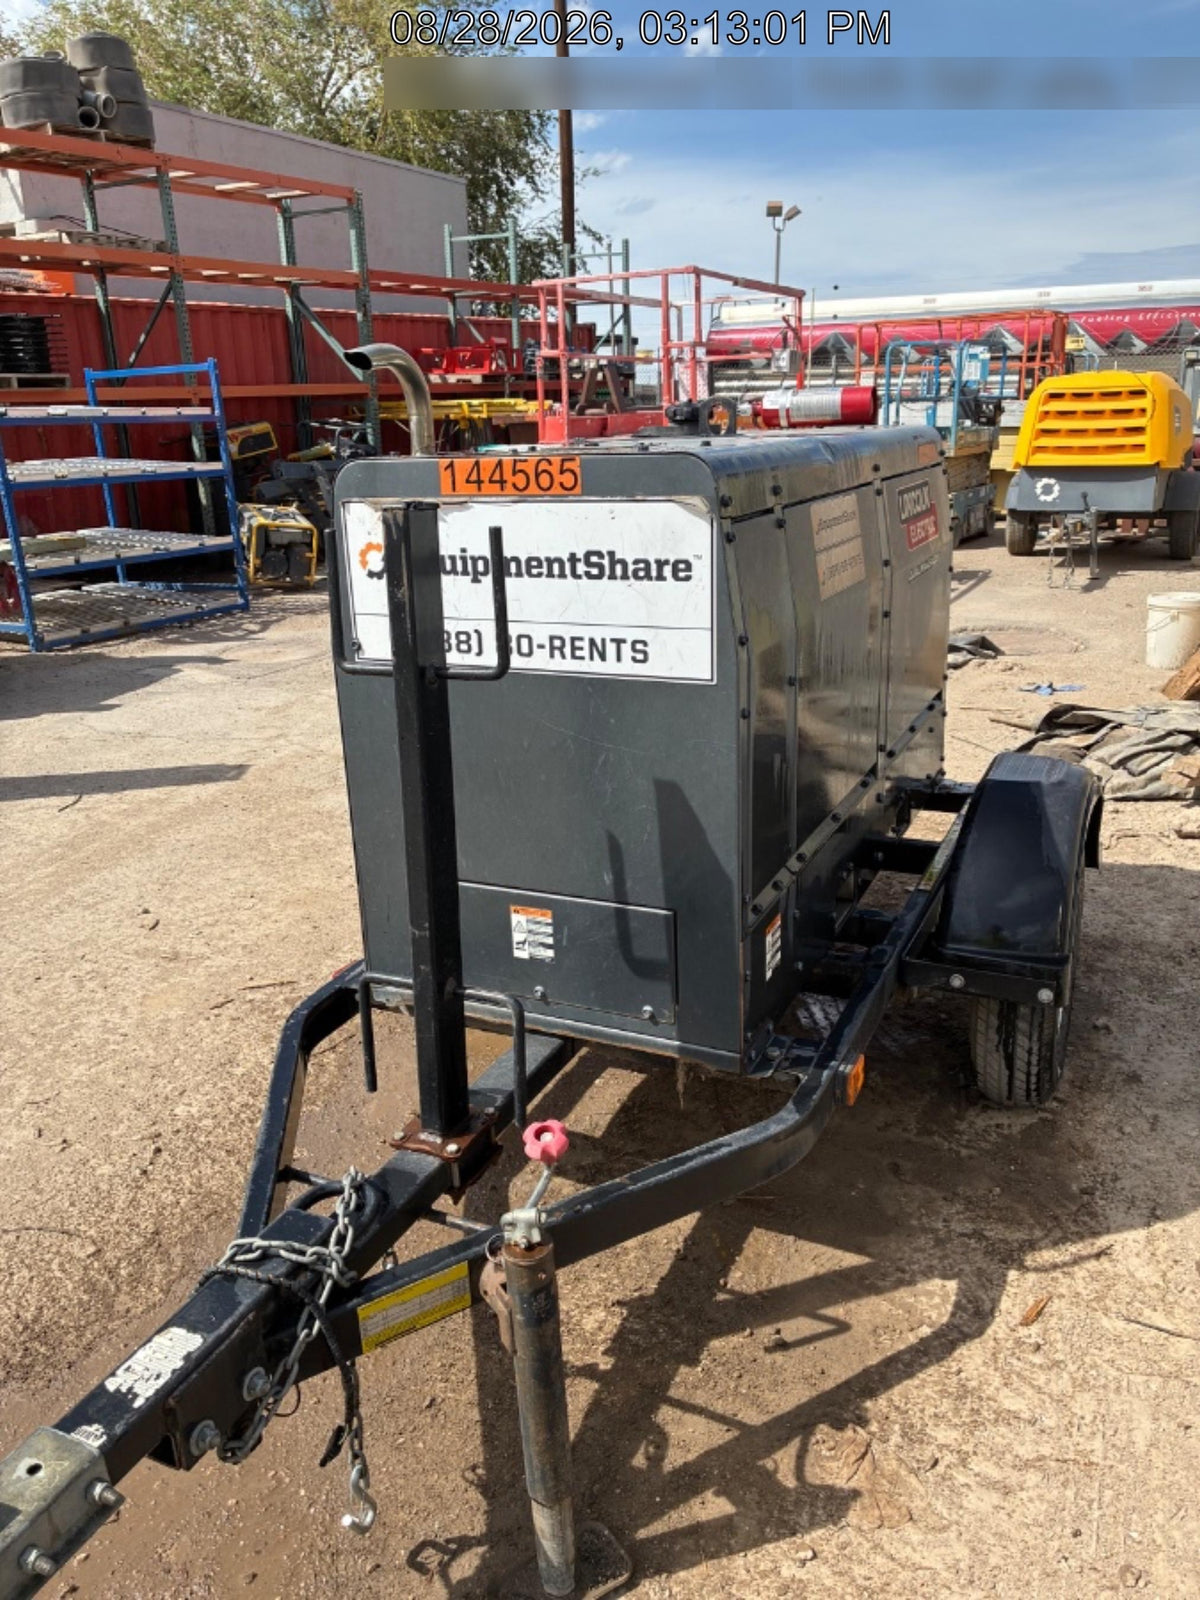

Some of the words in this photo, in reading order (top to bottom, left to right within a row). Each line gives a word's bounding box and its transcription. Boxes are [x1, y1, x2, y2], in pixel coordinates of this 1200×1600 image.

[442, 457, 580, 493] 144565
[439, 547, 693, 583] uipmentShare
[507, 632, 649, 665] 0-RENTS
